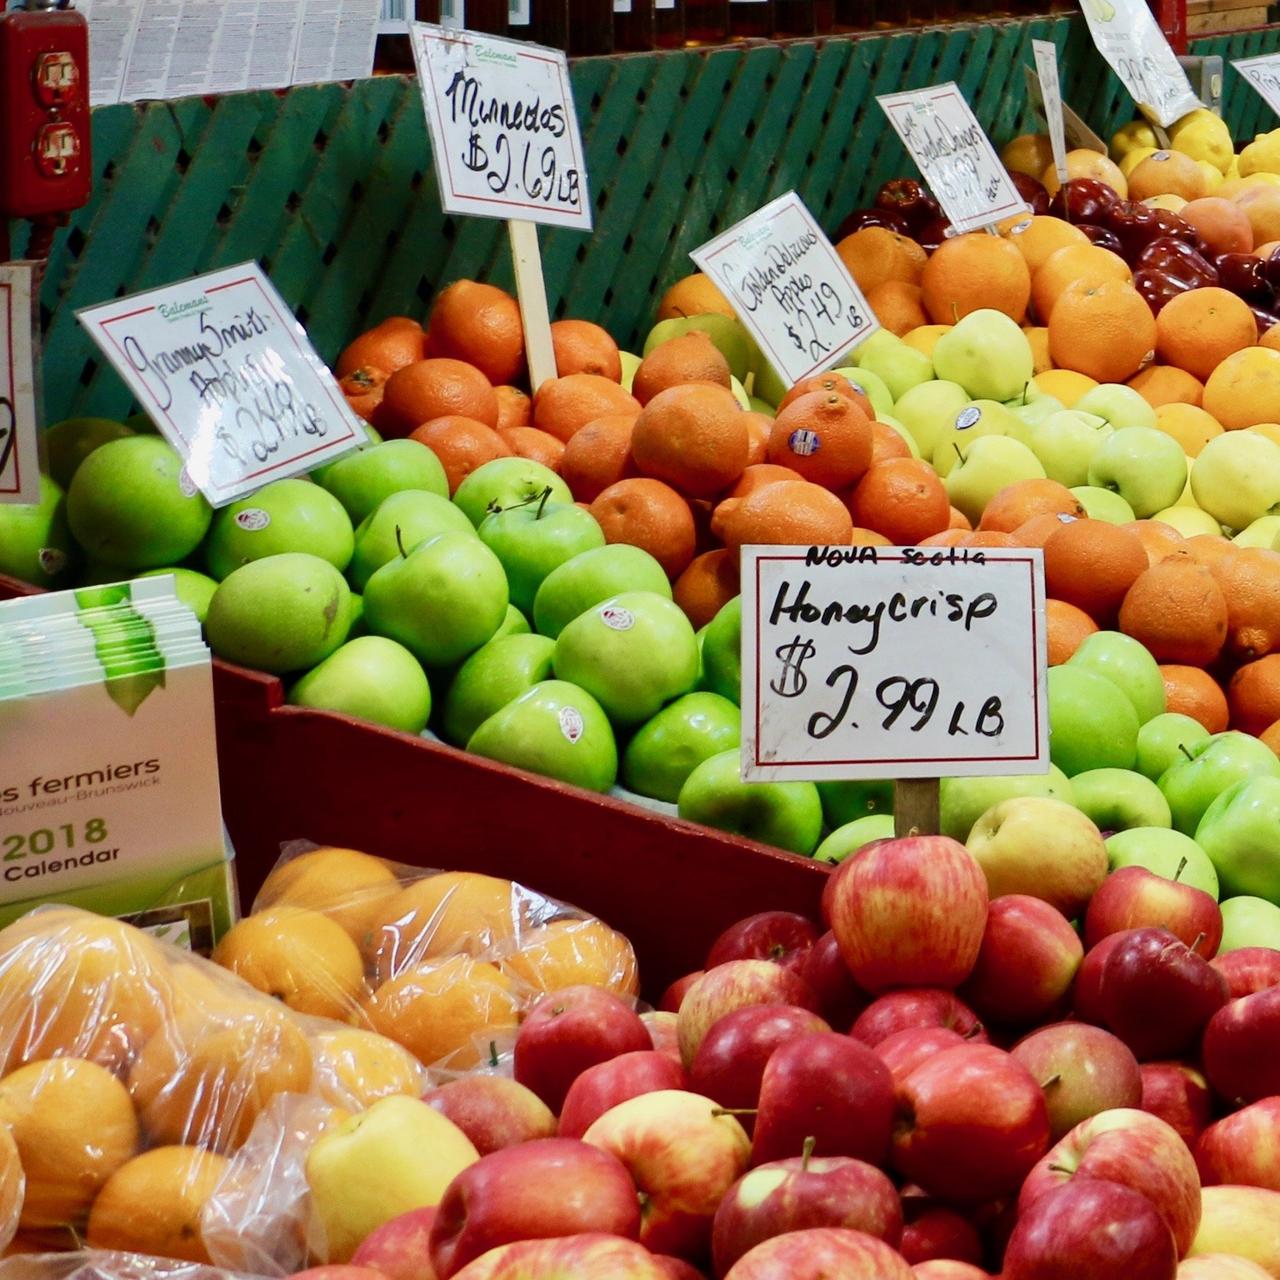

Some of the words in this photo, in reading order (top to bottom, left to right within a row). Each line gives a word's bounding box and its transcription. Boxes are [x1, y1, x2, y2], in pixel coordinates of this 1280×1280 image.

[474, 45, 517, 62] Balemans
[157, 295, 210, 318] Balemans
[784, 322, 807, 353] $
[805, 546, 877, 568] NOVA
[900, 548, 986, 567] Scotia
[769, 581, 998, 655] Honeycrisp
[770, 634, 816, 698] $
[807, 664, 940, 739] 2.99
[948, 695, 1004, 736] LB
[29, 758, 160, 797] fermiers
[2, 817, 108, 862] 2018
[4, 848, 120, 882] Calendar
